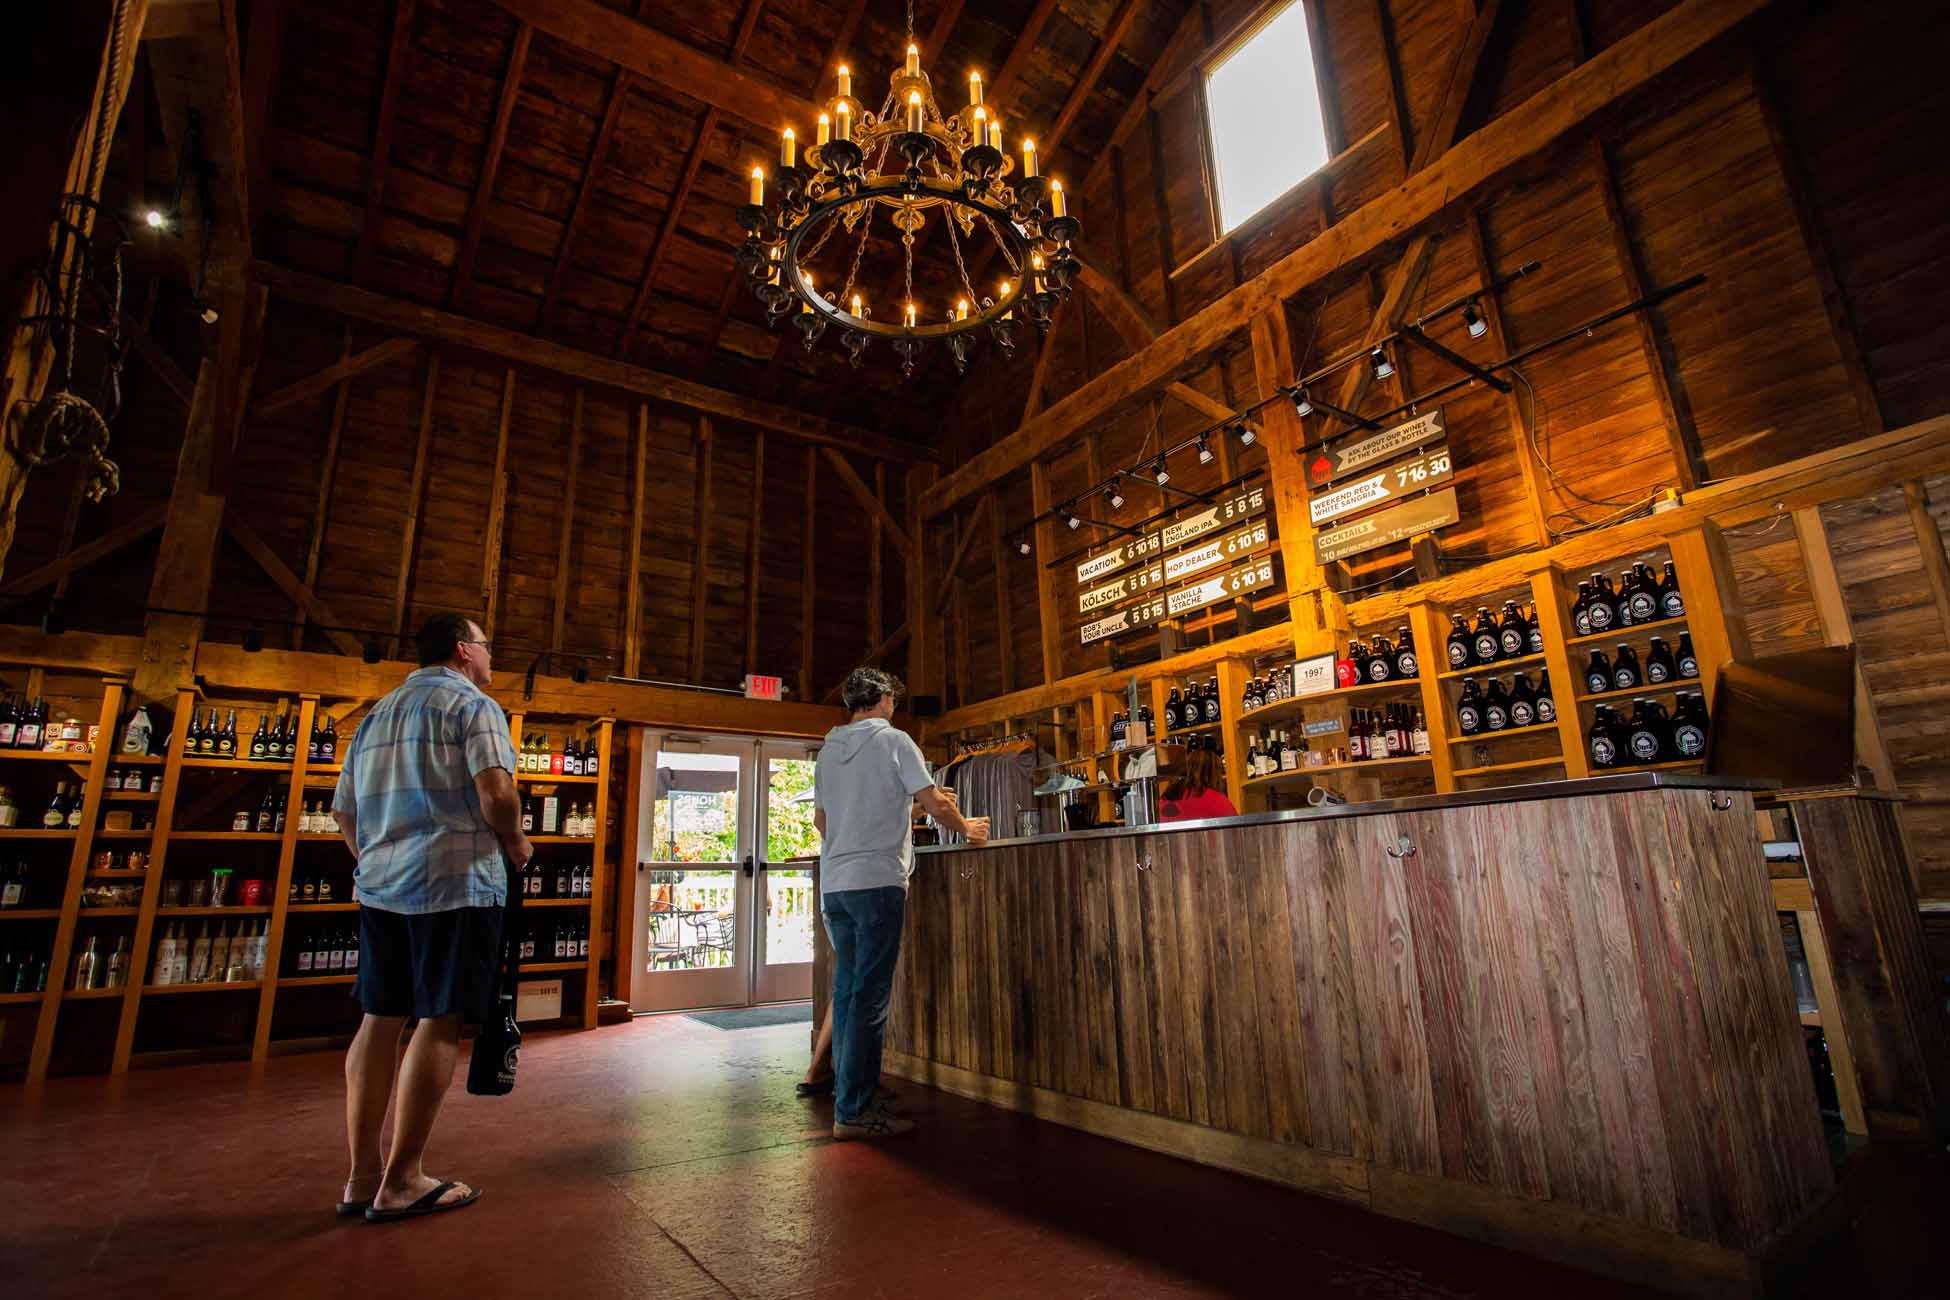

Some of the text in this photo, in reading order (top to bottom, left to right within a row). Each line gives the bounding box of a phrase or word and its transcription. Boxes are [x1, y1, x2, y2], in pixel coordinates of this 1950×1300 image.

[1348, 421, 1426, 457] ASK ABOUT OUR WINES
[1357, 450, 1371, 461] THE
[1372, 442, 1393, 454] GLASS
[1402, 428, 1428, 441] BOTTLE
[1397, 471, 1408, 488] 7
[1408, 465, 1427, 482] 16
[1430, 456, 1450, 476] 30
[1225, 493, 1263, 518] 5 8 15
[1313, 491, 1352, 511] WEEKEND
[1353, 484, 1370, 496] RED
[1315, 490, 1377, 517] WHITE SANGRIA
[1165, 524, 1183, 537] NEW
[1166, 525, 1200, 544] ENGLAND
[1201, 520, 1213, 529] IPA
[1320, 525, 1369, 547] COCKTAILS
[1080, 556, 1117, 577] VACATION
[1127, 547, 1135, 559] 6
[1136, 542, 1147, 555] 10
[1147, 536, 1159, 550] 18
[1168, 528, 1266, 574] HOP DEALER 6 10 18
[1082, 569, 1161, 609] KÖLSCH 5 8 15
[1232, 566, 1271, 590] 6 10 18
[1171, 587, 1203, 604] VANILLA
[1133, 603, 1163, 623] 5 8 15
[1083, 623, 1101, 634] BOB'S
[1083, 623, 1122, 641] YOUR UNCLE
[1304, 666, 1324, 678] 1997
[752, 675, 777, 698] EXIT
